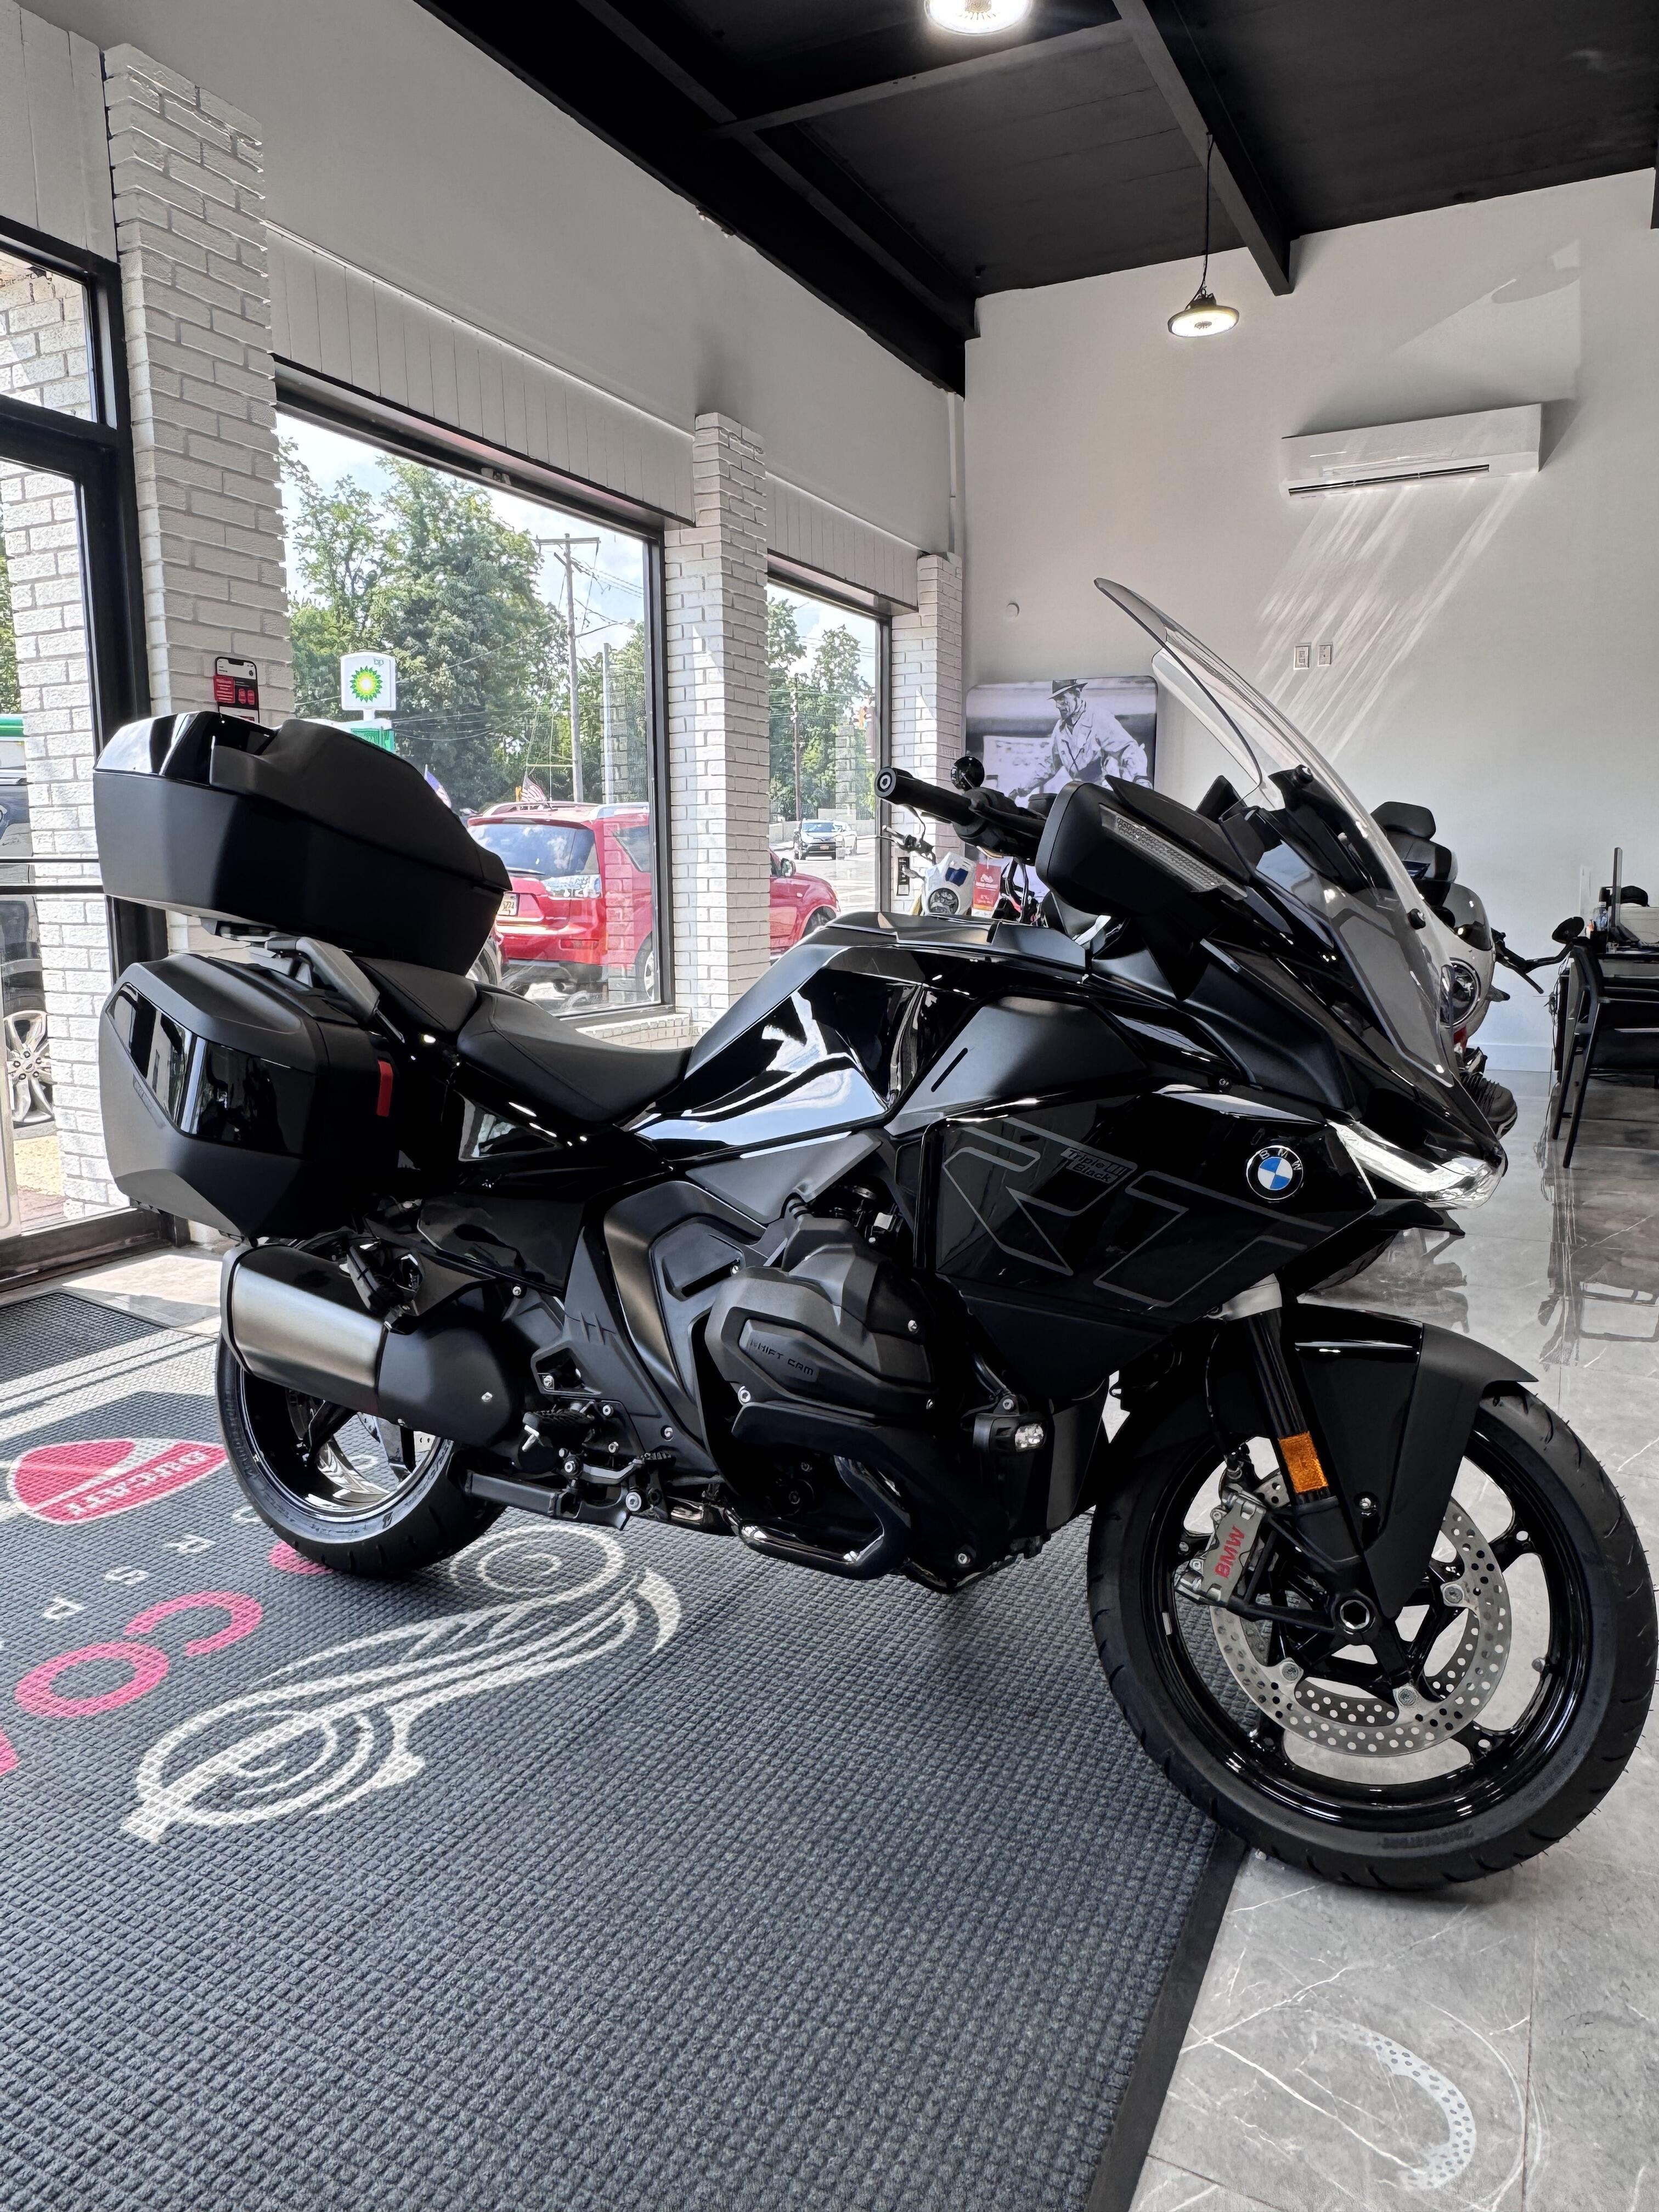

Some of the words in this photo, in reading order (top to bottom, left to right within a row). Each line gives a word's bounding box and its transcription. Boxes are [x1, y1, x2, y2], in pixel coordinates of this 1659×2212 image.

[1068, 1149, 1105, 1169] Triple
[1259, 1148, 1302, 1171] BMW
[1072, 1163, 1111, 1182] Black
[787, 1358, 814, 1376] CAM
[64, 1450, 210, 1518] DUCATI
[1215, 1525, 1245, 1578] BMW
